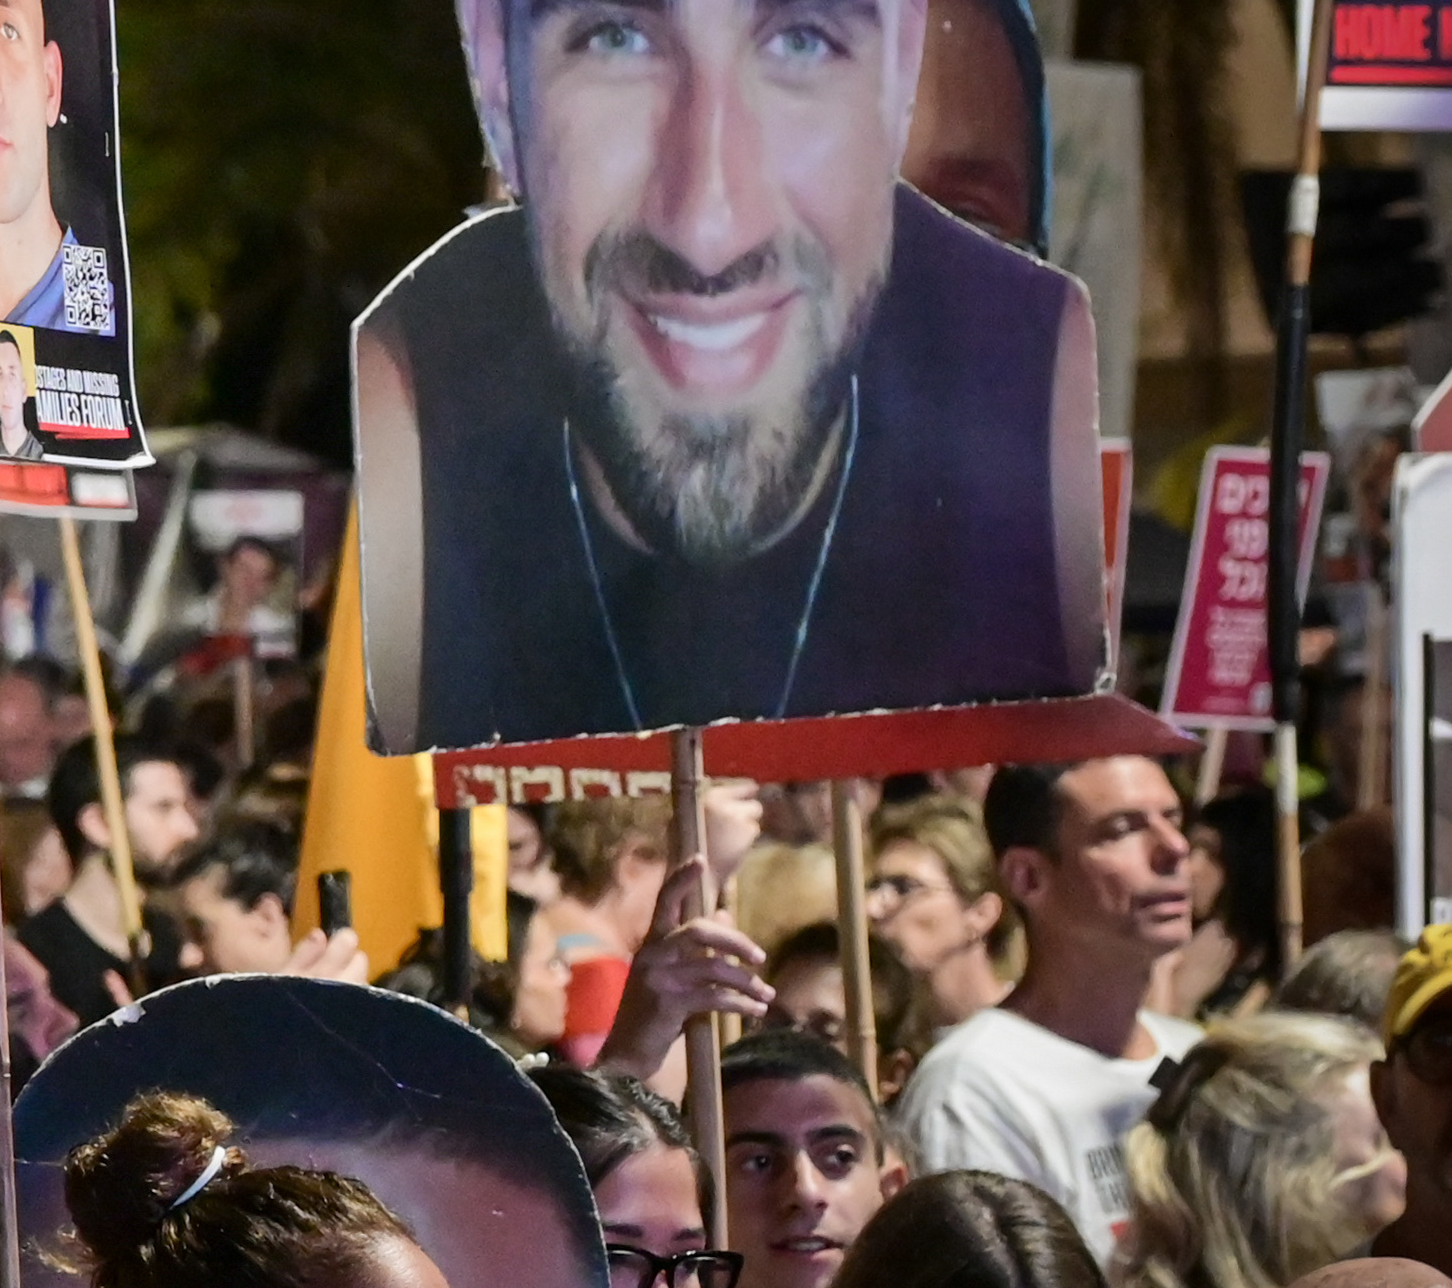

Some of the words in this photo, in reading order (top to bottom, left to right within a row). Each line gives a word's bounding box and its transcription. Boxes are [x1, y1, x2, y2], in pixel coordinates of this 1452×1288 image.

[1334, 4, 1432, 61] HOME
[35, 389, 82, 427] AMILIES
[80, 394, 126, 430] FORUM
